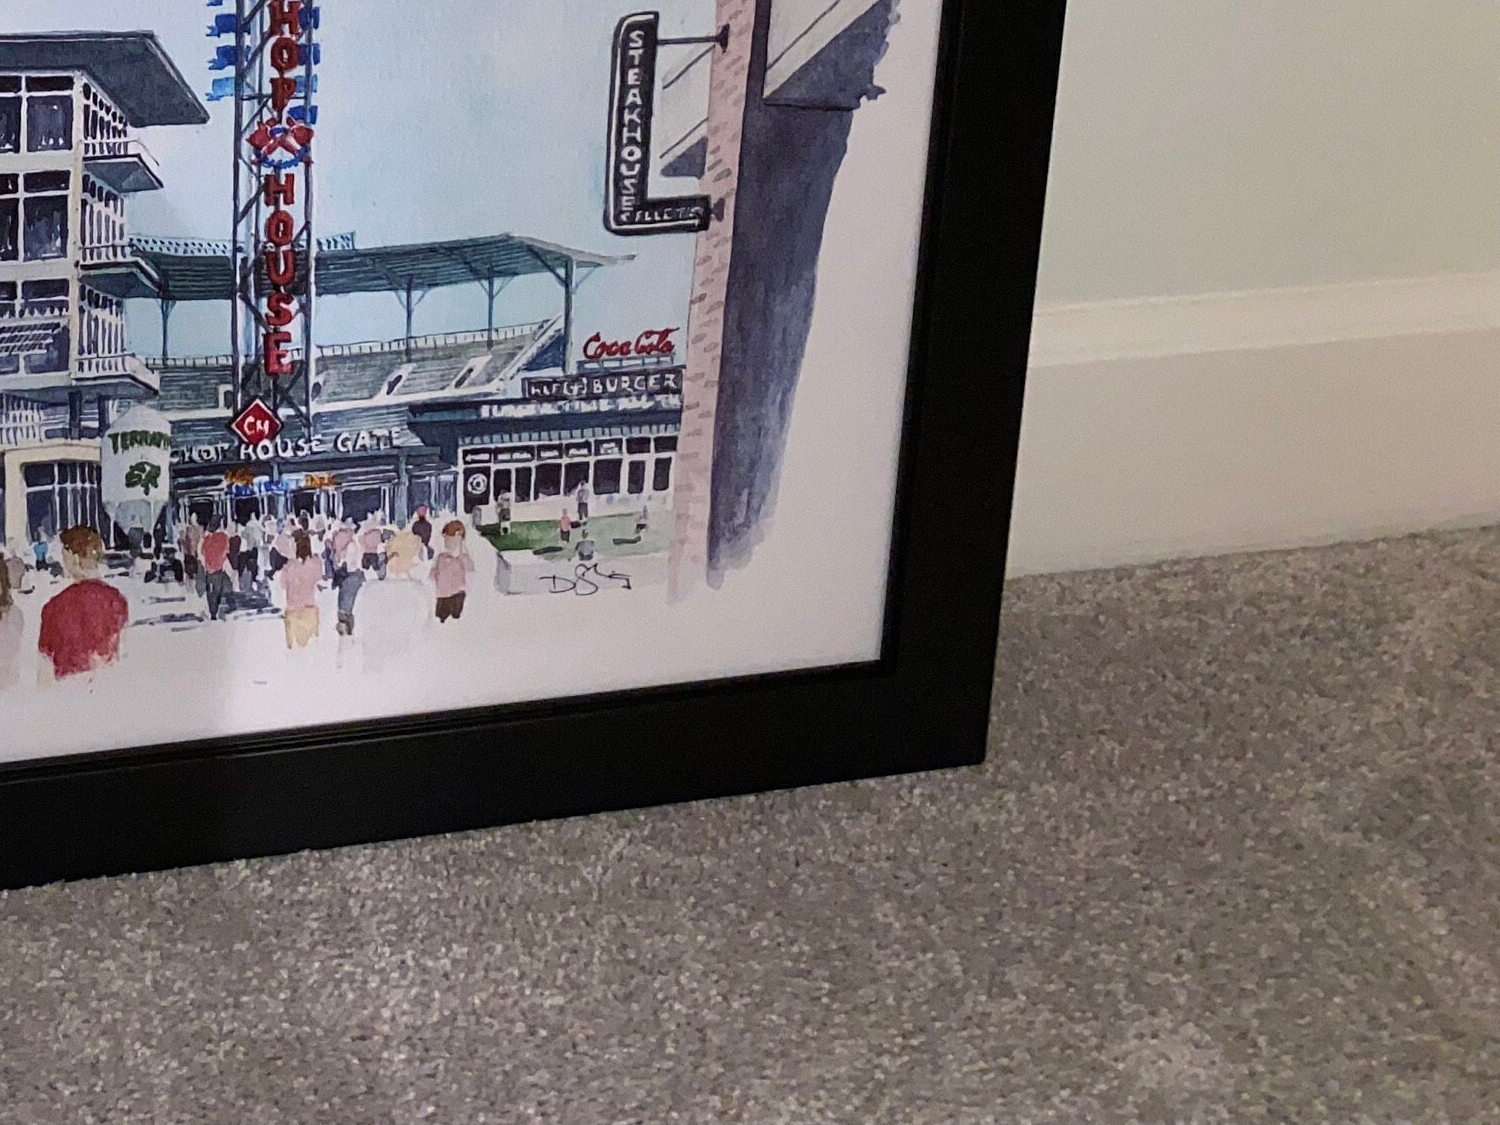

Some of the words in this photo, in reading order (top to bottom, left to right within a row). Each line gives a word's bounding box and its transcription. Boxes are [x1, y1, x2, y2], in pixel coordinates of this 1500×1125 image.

[619, 29, 645, 212] STEAKHOUSE
[264, 173, 296, 376] HOUSE
[592, 373, 678, 394] BURGER
[239, 434, 327, 461] HOUSE
[336, 427, 401, 453] GATE
